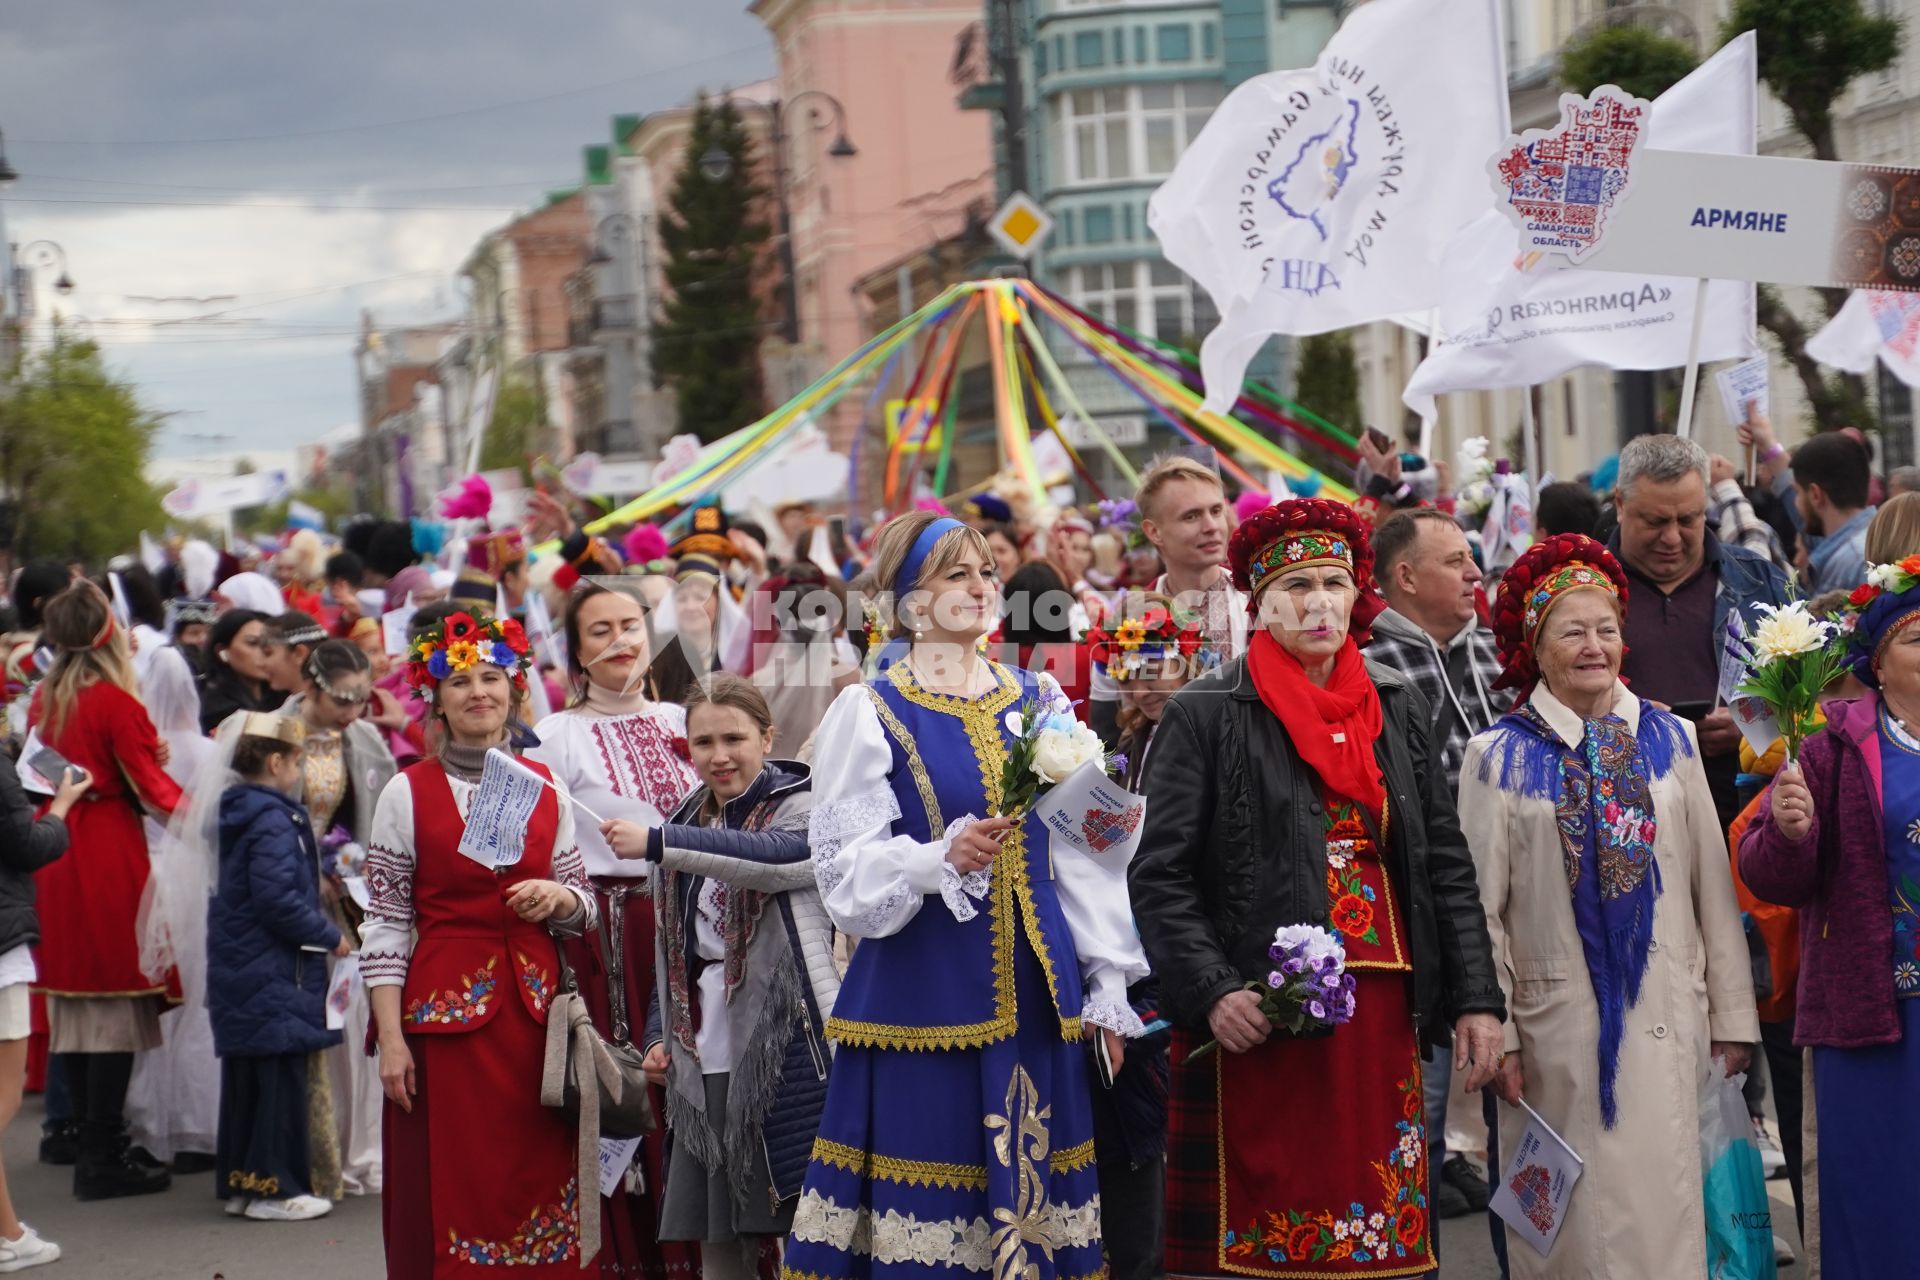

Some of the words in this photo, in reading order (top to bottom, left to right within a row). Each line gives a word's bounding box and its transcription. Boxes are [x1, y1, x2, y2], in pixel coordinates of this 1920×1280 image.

[1526, 221, 1592, 236] САМАРСКАЯ
[1690, 206, 1788, 233] АРМЯНЕ
[1532, 235, 1582, 249] ОБЛАСТЬ
[1089, 790, 1112, 811] ОБЛАСТЬ
[1094, 786, 1125, 809] САМАРСКАЯ
[487, 773, 514, 849] Мы-вместе
[1056, 808, 1073, 825] МЫ
[1048, 815, 1084, 845] ВМЕСТЕ!
